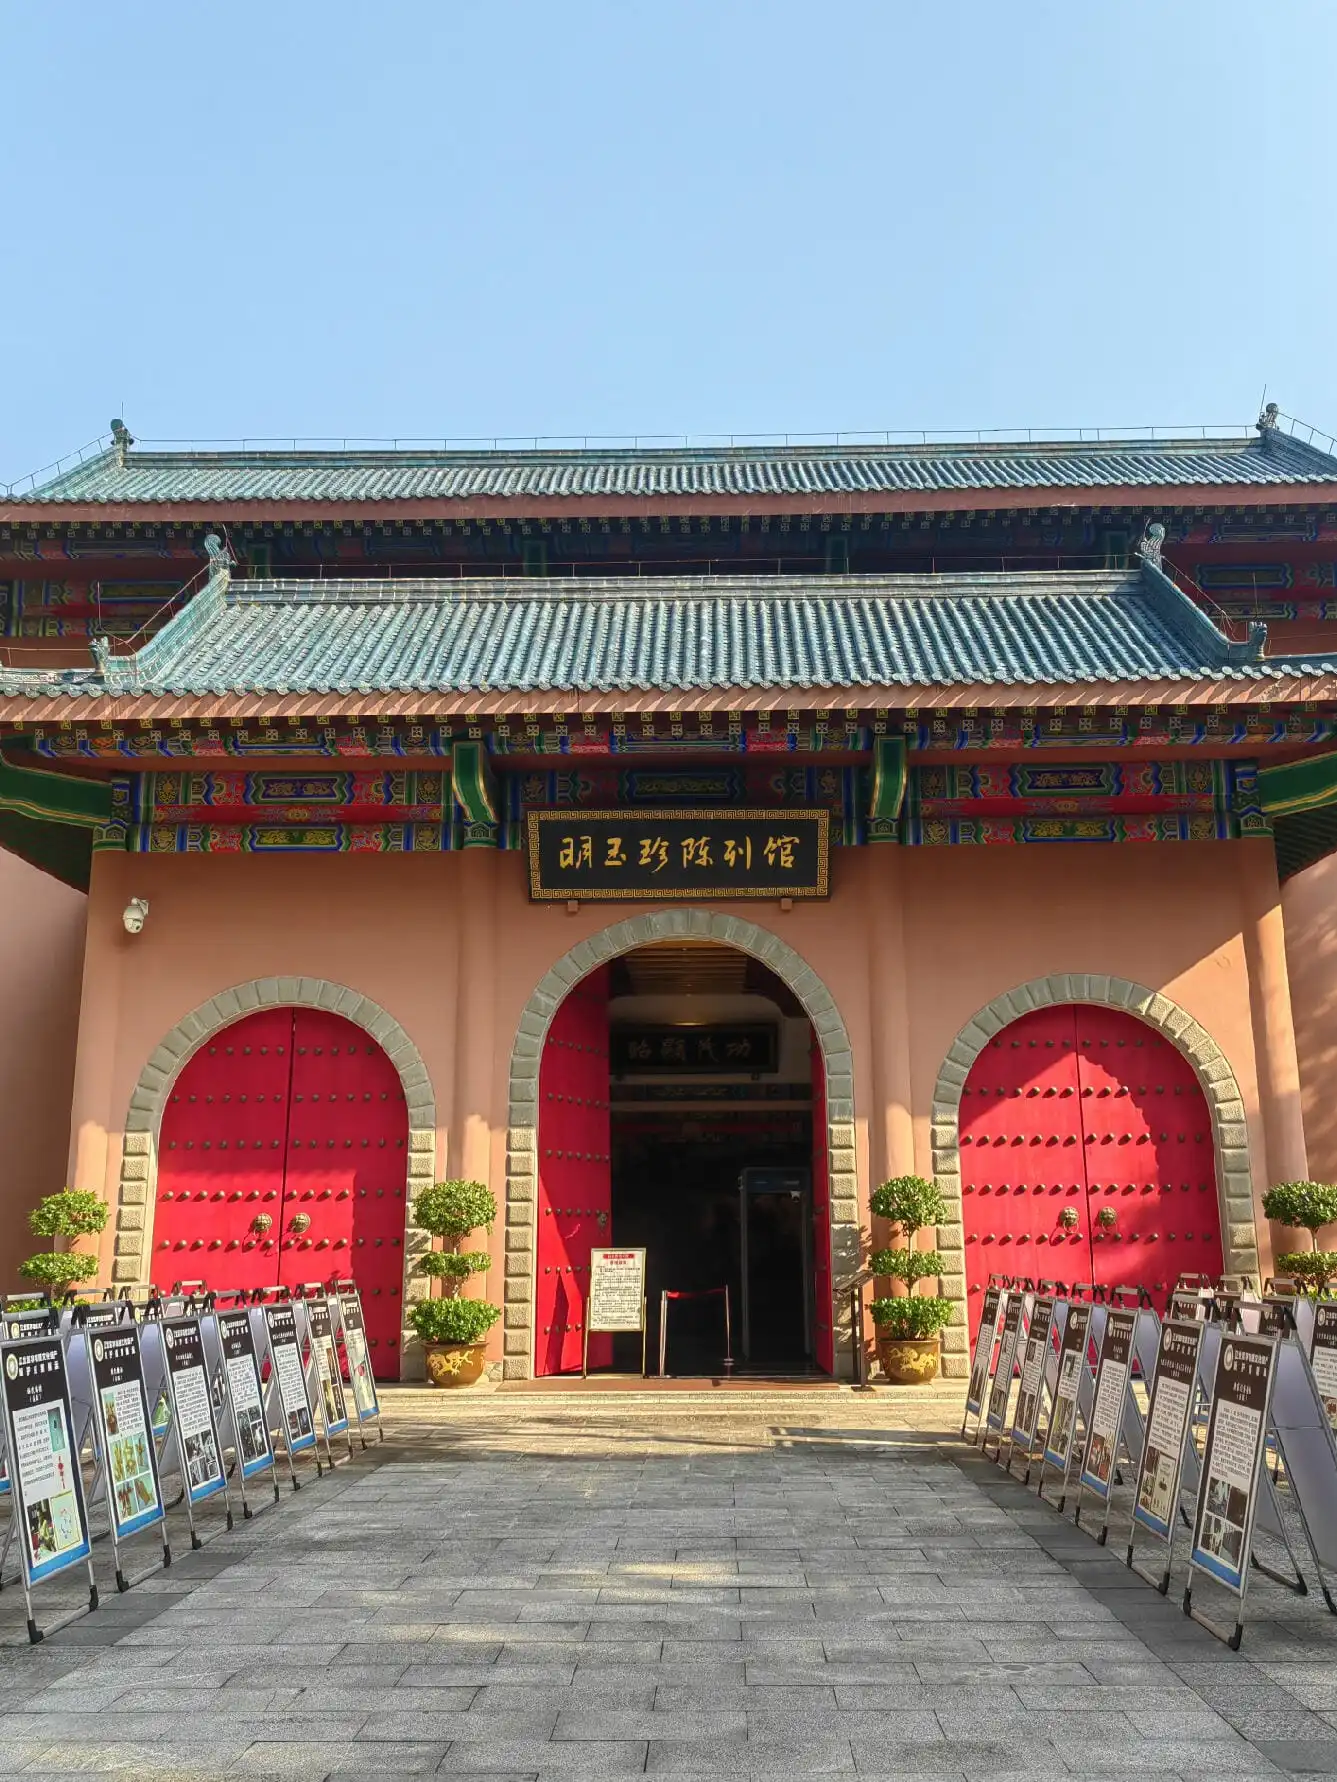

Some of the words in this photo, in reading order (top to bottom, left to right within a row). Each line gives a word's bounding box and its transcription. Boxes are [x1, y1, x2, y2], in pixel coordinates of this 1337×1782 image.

[559, 835, 800, 873] 明玉珍陈列馆
